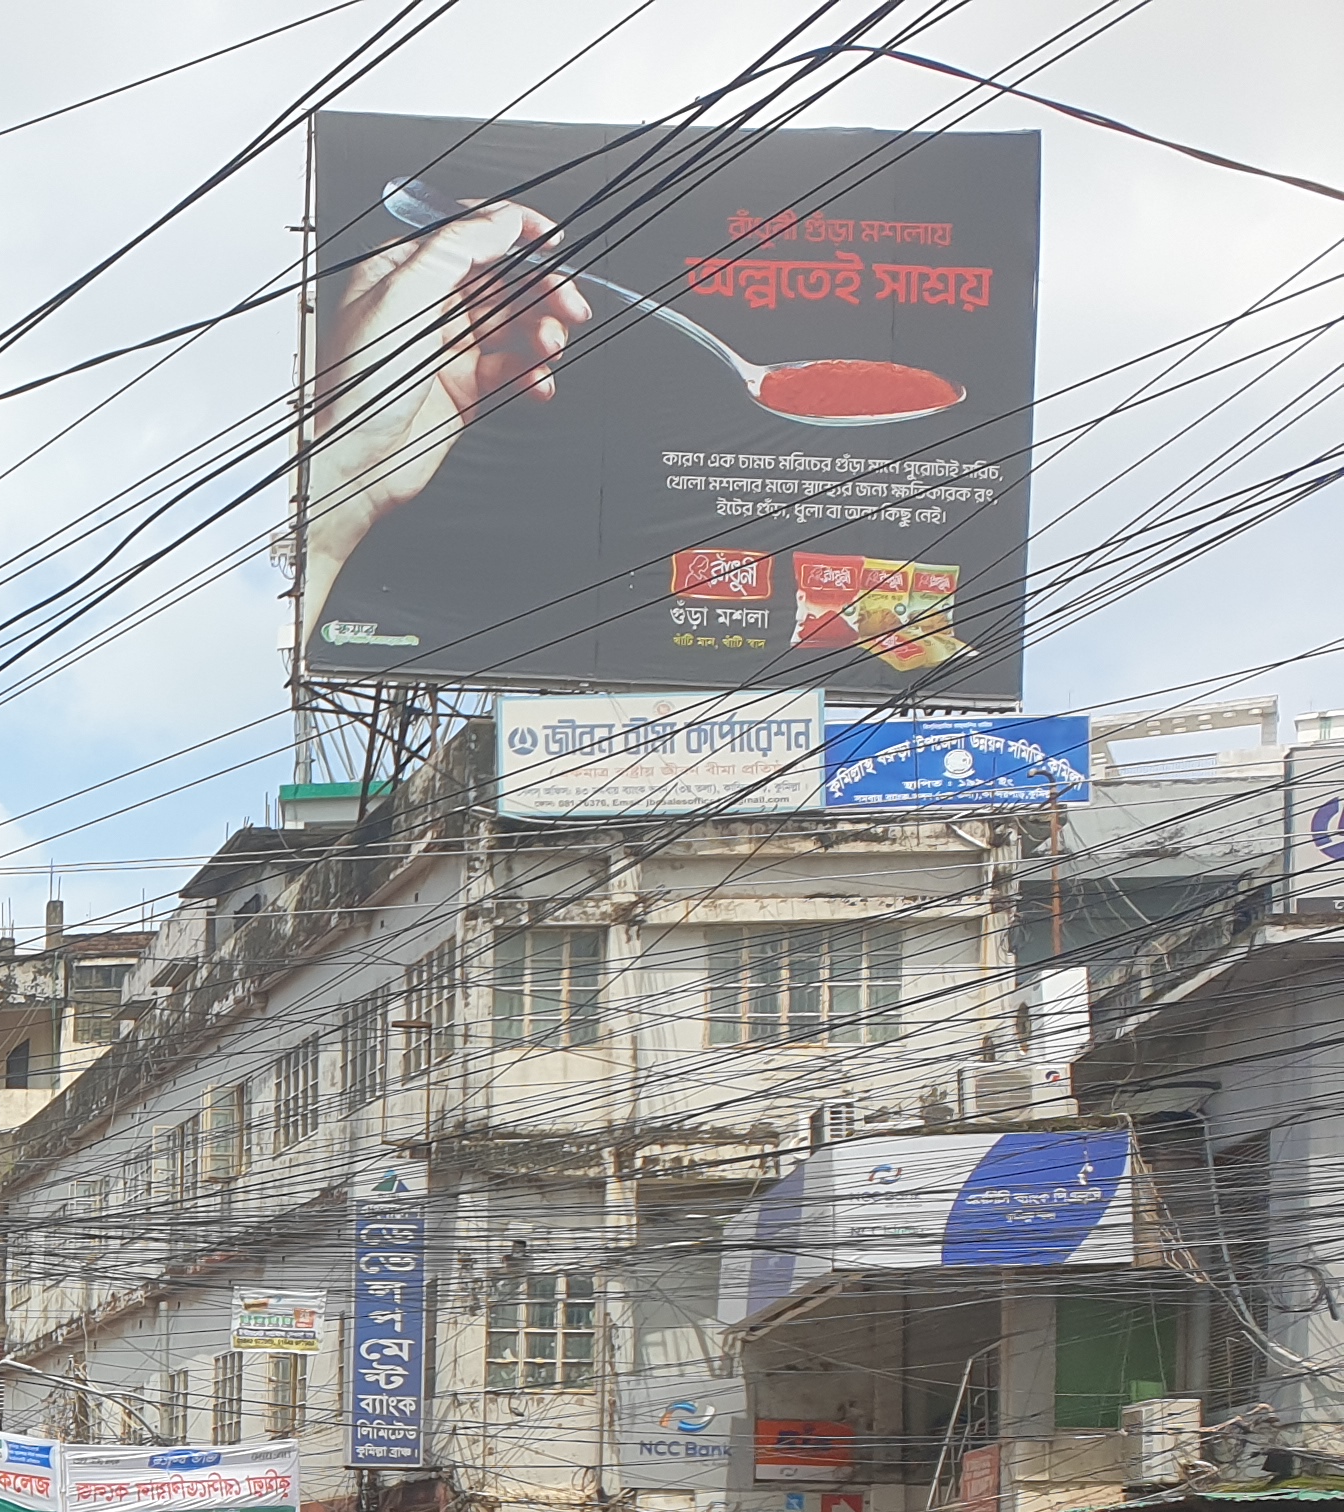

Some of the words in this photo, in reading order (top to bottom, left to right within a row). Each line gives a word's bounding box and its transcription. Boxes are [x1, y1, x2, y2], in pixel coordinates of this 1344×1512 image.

[860, 220, 953, 248] মশলায়
[685, 251, 865, 310] অল্পতেই
[872, 263, 993, 312] সাশ্রয়
[662, 451, 705, 468] কারণ
[708, 453, 736, 468] এক
[738, 454, 776, 469] চামচ
[778, 452, 831, 472] মরিচের
[667, 475, 706, 490] খোলা
[708, 477, 763, 494] মশলার
[856, 483, 888, 498] জন্য
[716, 497, 753, 517] ইটের
[826, 505, 842, 519] বা
[670, 600, 709, 632] গুঁড়া
[715, 608, 769, 629] মশলা
[542, 719, 616, 757] জীবন
[359, 1392, 417, 1418] ব্যাংক
[639, 1440, 680, 1457] NCC
[684, 1441, 733, 1458] Bank
